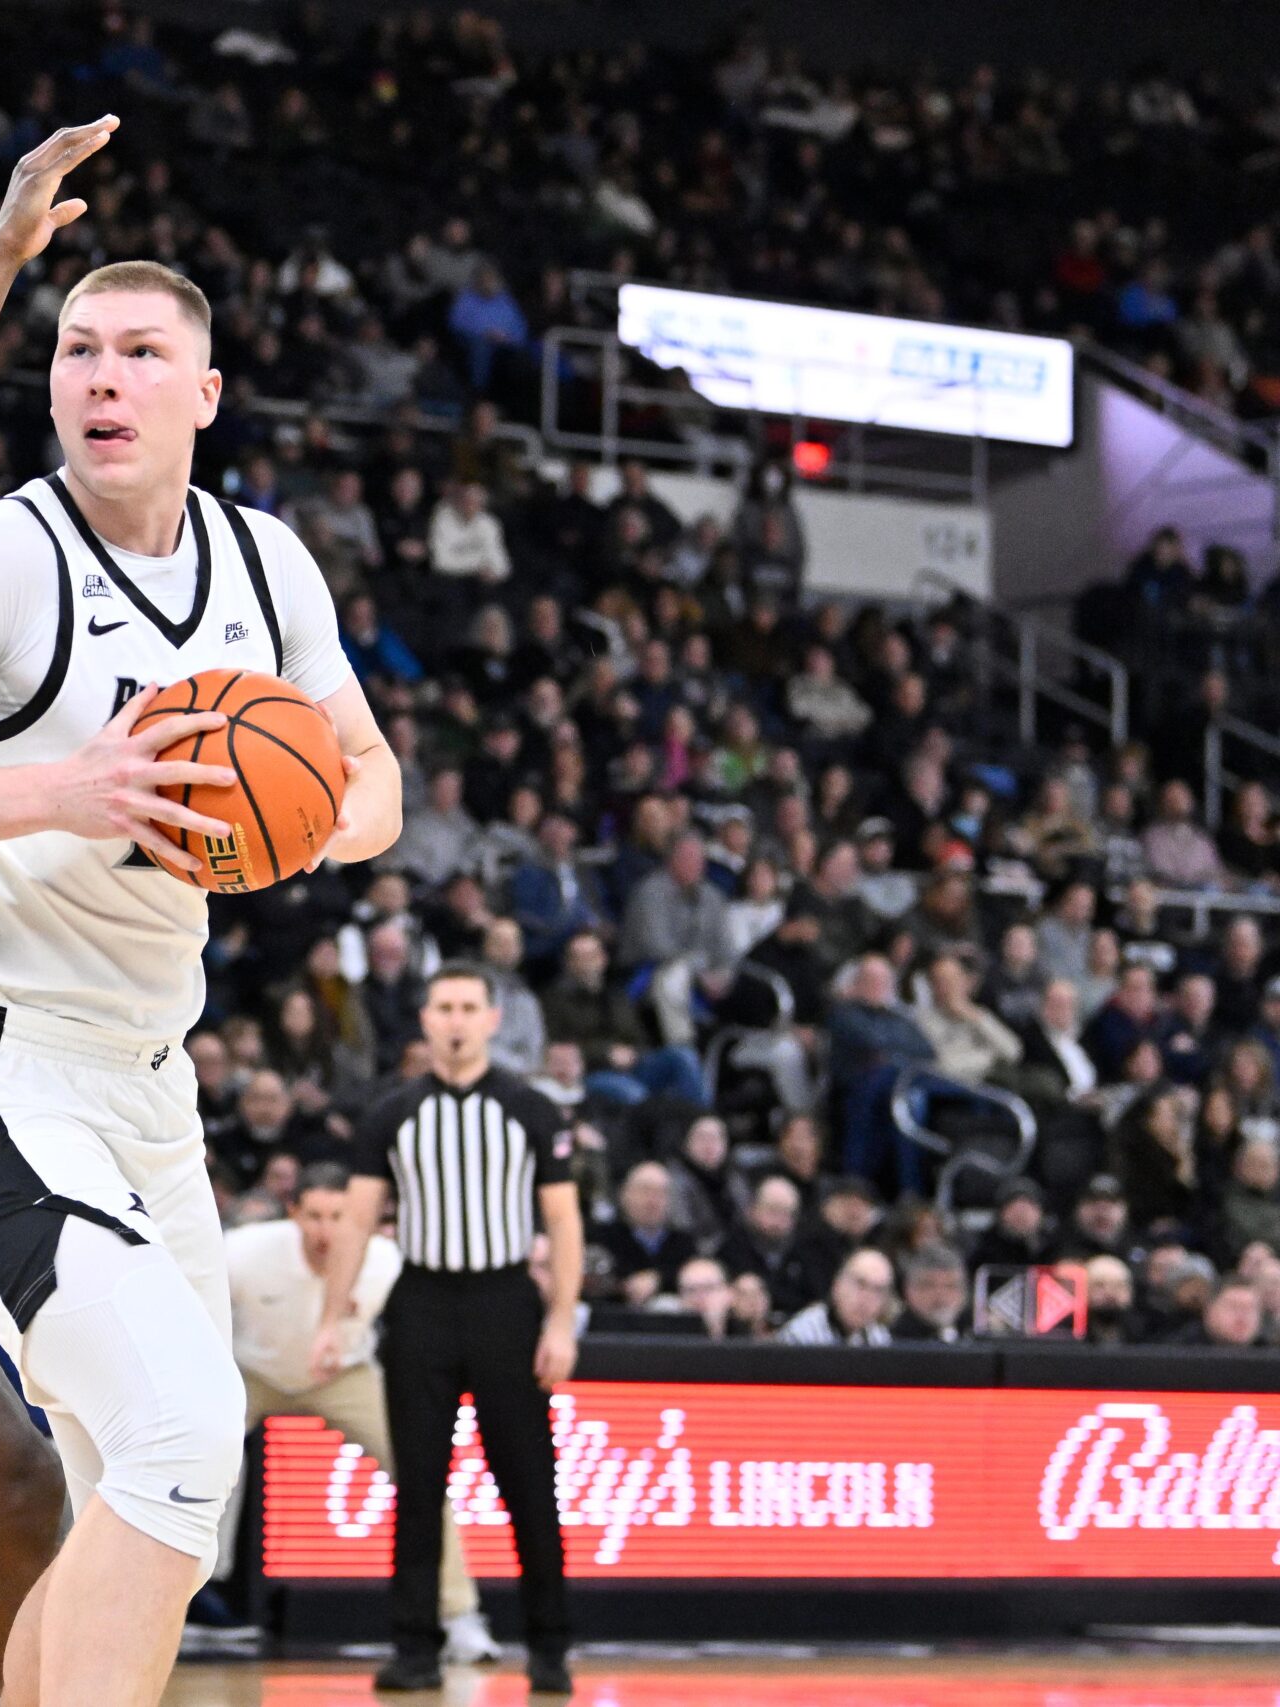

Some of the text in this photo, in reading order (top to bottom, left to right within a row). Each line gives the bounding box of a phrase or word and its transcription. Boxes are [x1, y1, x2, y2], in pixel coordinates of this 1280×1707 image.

[225, 621, 243, 632] BIG
[225, 629, 249, 641] EAST
[709, 1460, 934, 1527] LINCOLN
[1039, 1403, 1280, 1566] Ball
